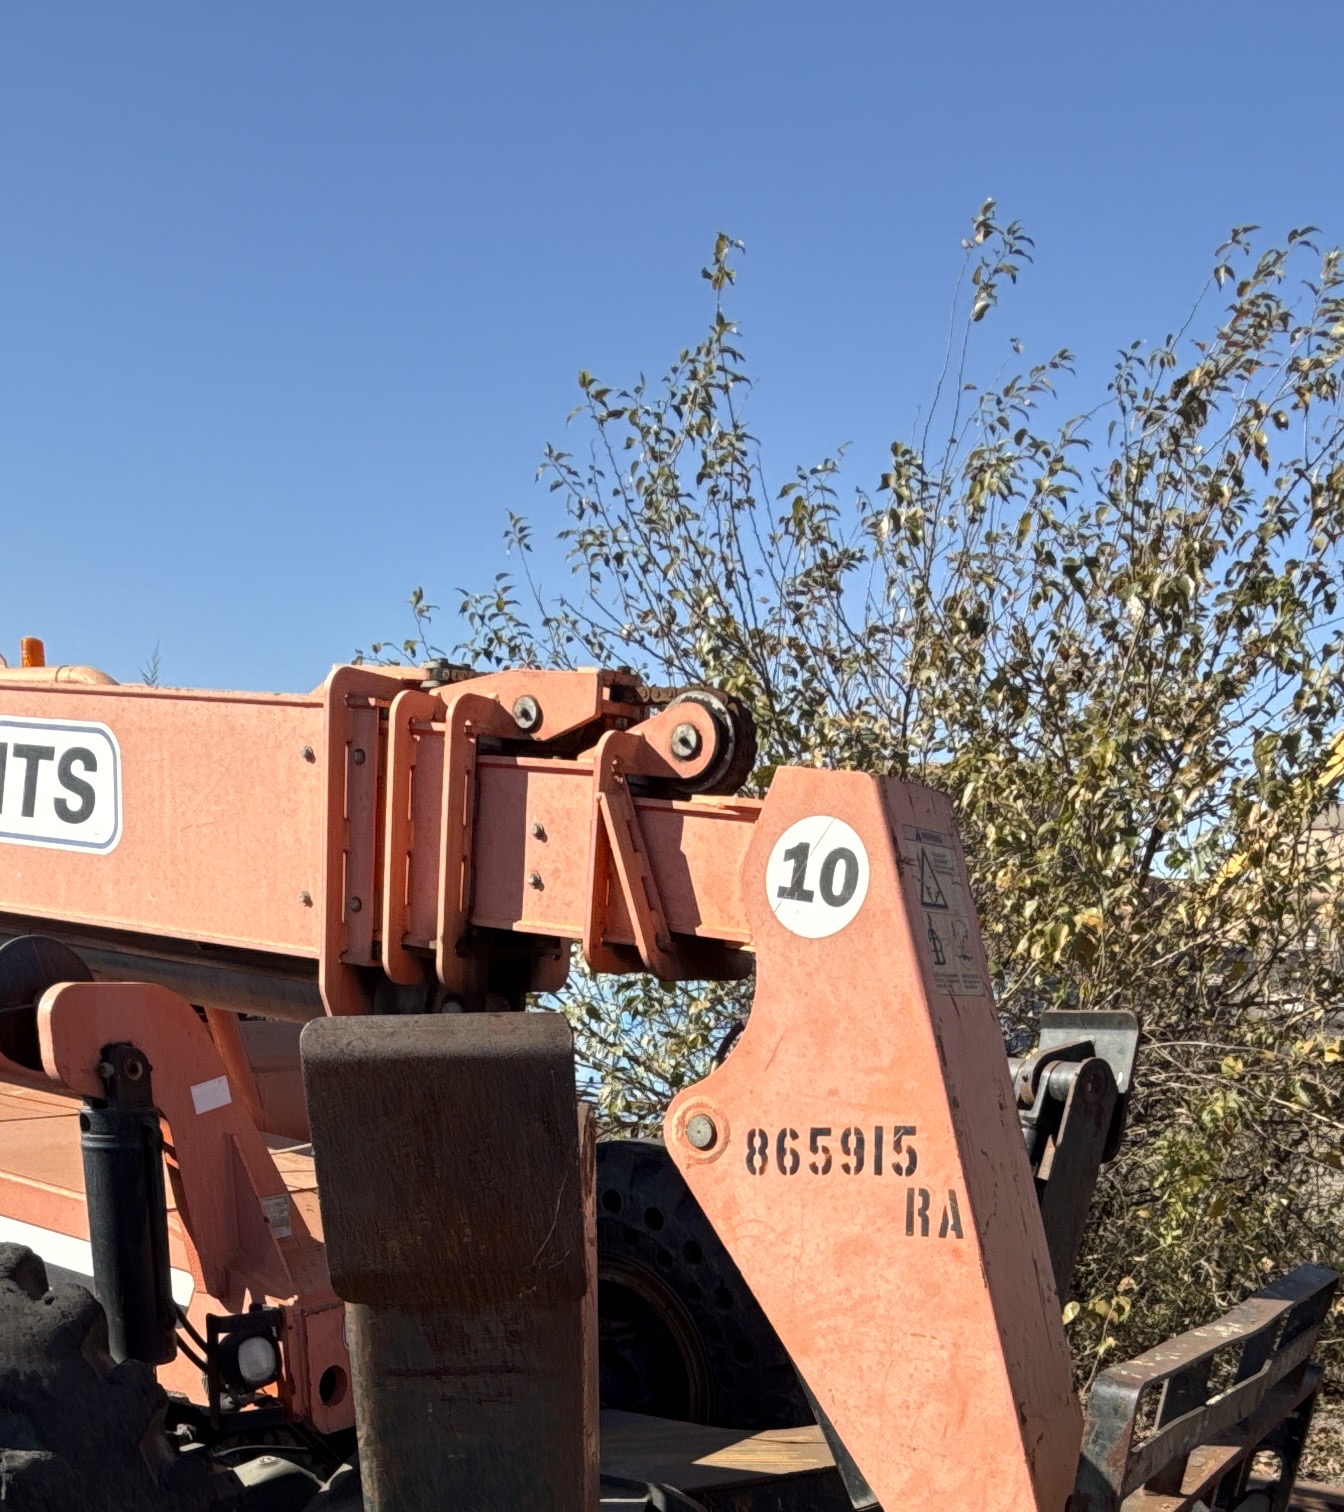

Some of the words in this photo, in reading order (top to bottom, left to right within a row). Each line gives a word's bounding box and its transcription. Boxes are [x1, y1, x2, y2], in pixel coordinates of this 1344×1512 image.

[777, 841, 860, 908] 10
[745, 1126, 918, 1178] 865915
[905, 1187, 964, 1240] RA
